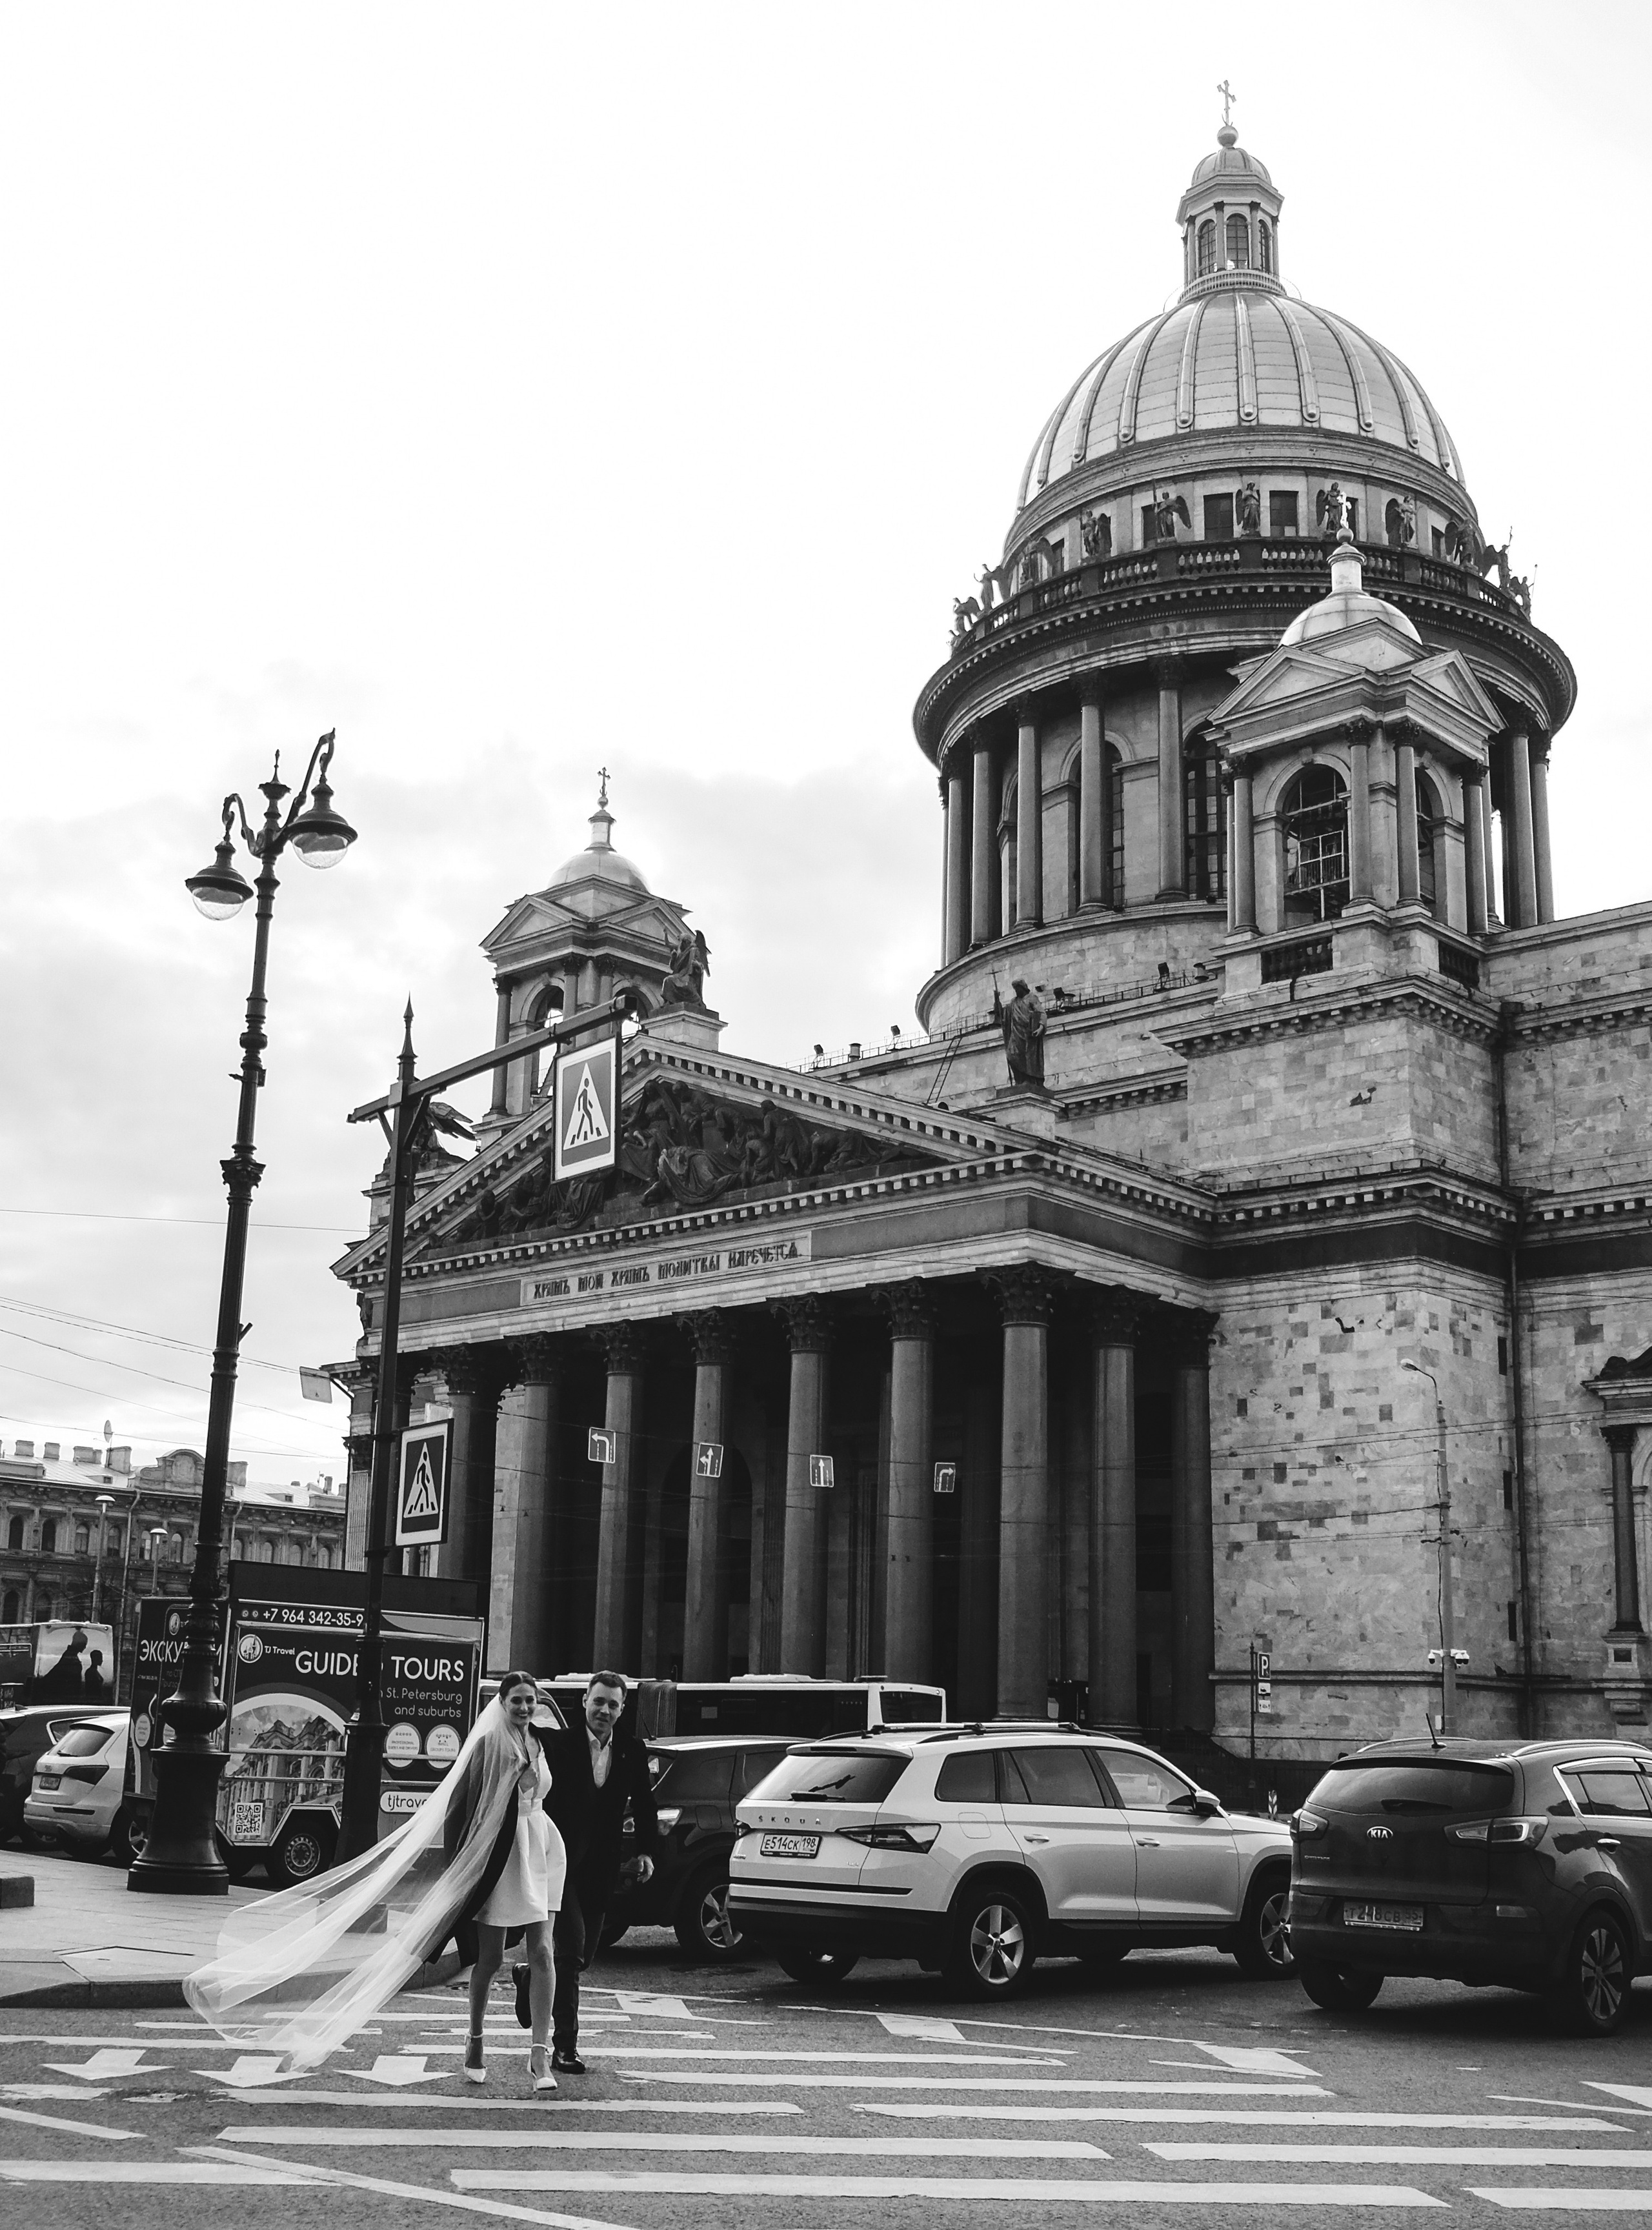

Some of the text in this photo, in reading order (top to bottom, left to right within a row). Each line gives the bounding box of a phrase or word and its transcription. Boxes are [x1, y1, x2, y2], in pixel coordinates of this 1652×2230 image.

[263, 1609, 363, 1627] +7 964 342-35-9
[273, 1646, 296, 1655] Travel
[296, 1651, 464, 1682] GUID TOURS
[1261, 1656, 1269, 1676] P
[387, 1687, 399, 1698] St.
[401, 1687, 463, 1705] Petersburg
[394, 1705, 461, 1718] and suburbs
[1371, 1829, 1388, 1839] KIA
[764, 1837, 816, 1851] Е514СК 198
